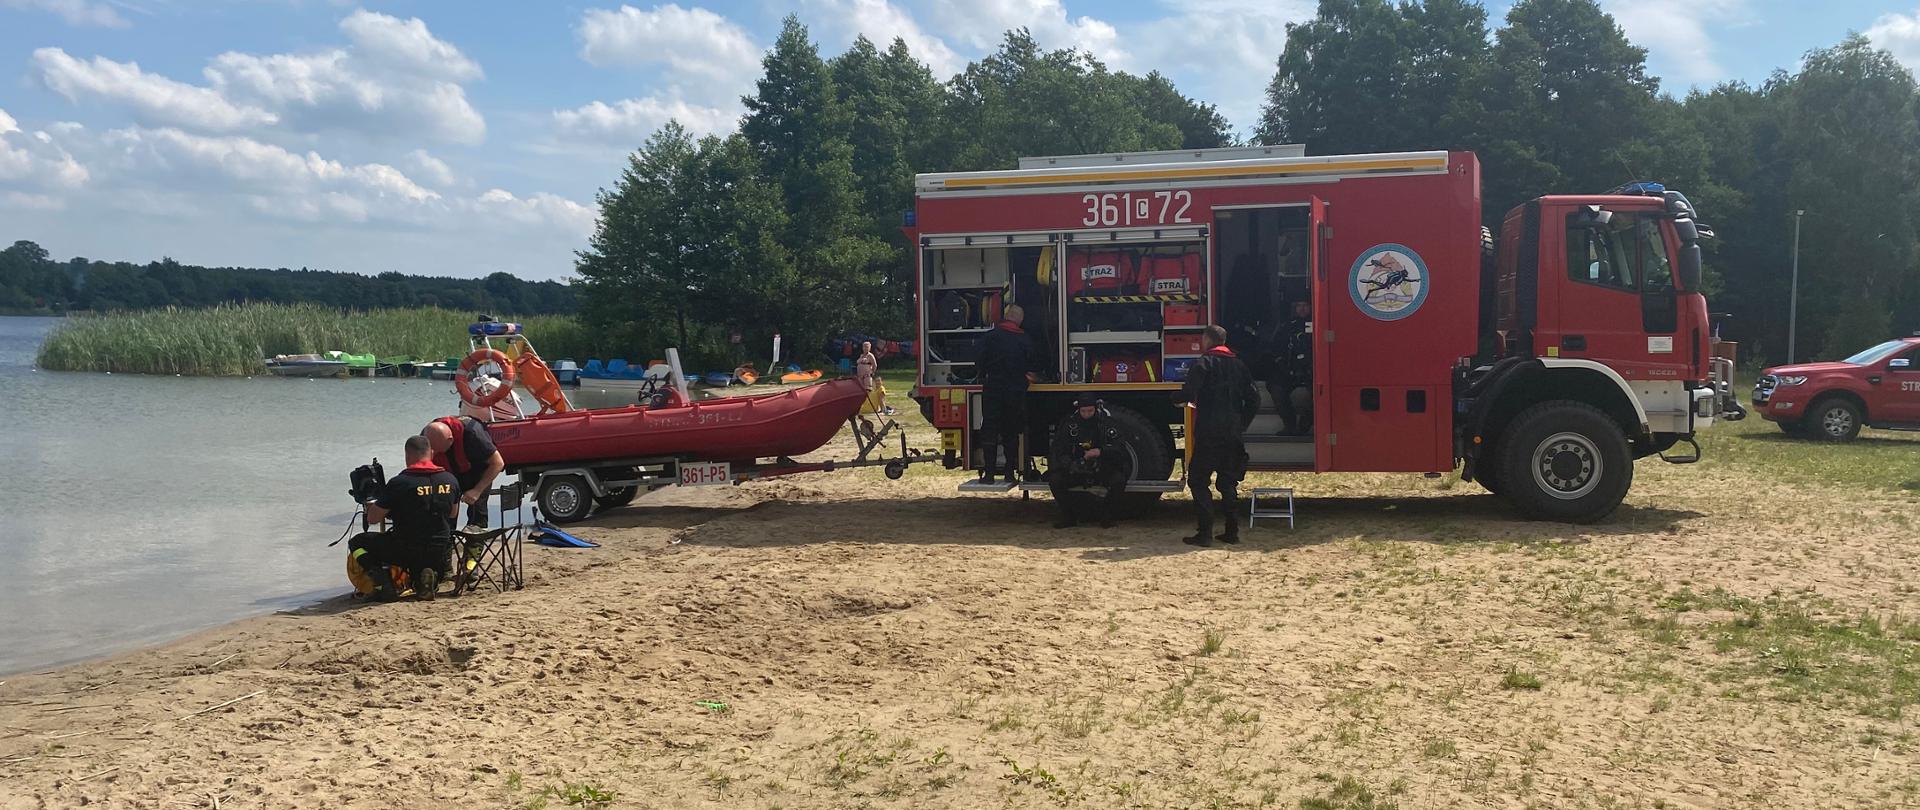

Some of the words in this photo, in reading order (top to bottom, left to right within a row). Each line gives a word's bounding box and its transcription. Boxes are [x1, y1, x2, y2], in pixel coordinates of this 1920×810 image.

[1082, 193, 1131, 226] 361
[1138, 200, 1147, 217] C
[1154, 190, 1192, 224] 72
[1157, 281, 1184, 290] STRA
[683, 466, 726, 484] 361-P5
